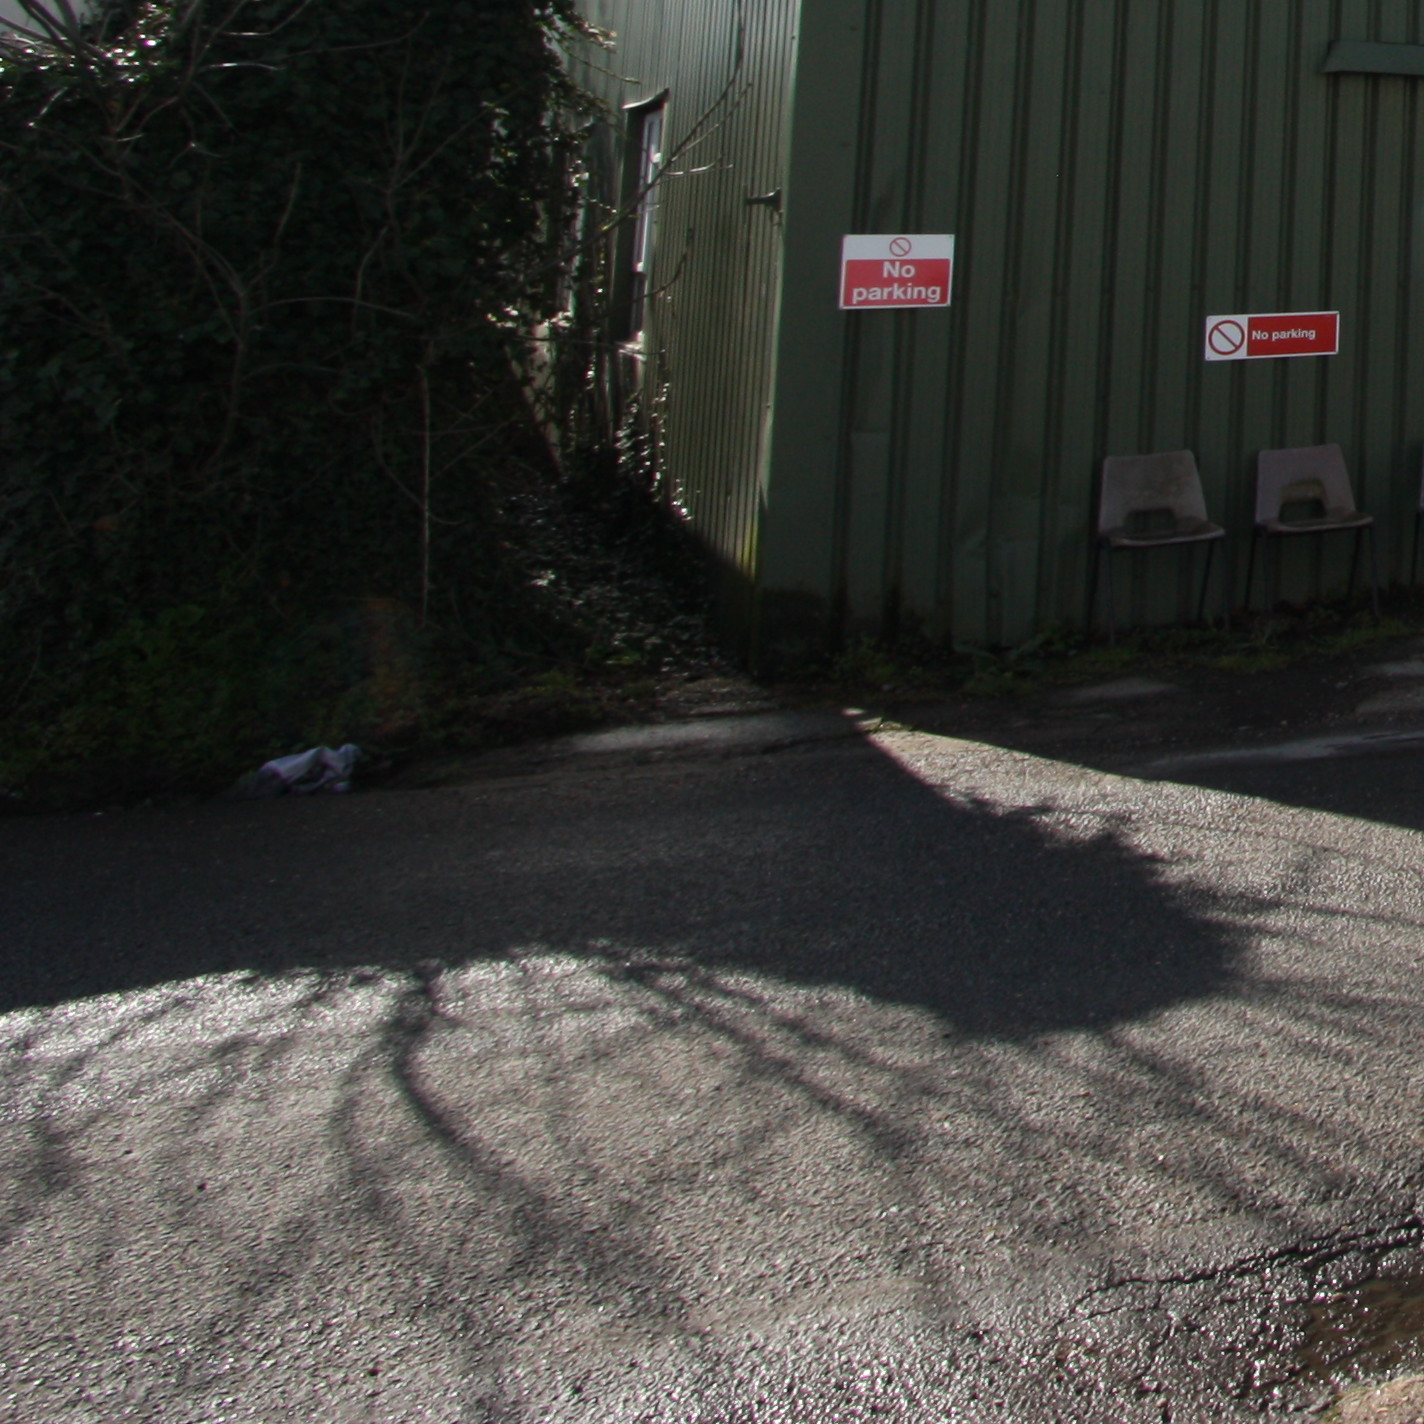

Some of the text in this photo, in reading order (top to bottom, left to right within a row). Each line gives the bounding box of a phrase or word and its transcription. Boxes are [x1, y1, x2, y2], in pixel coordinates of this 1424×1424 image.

[882, 261, 915, 278] No
[852, 283, 941, 305] parking
[1252, 329, 1316, 341] No parking
